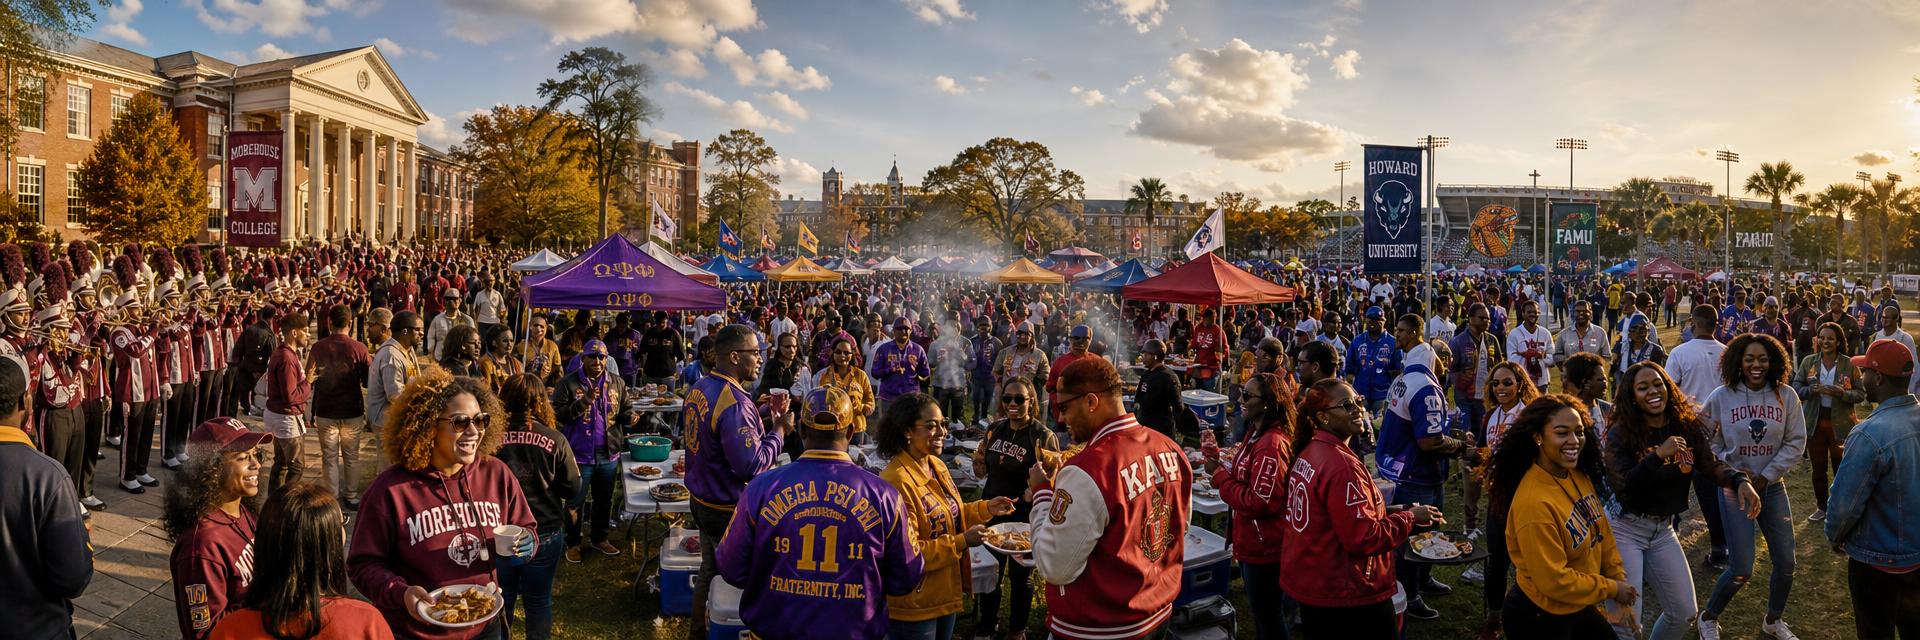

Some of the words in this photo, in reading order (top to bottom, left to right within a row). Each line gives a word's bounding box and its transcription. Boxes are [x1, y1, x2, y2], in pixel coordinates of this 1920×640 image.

[231, 143, 279, 160] MOREHOUSE
[1368, 160, 1418, 176] HOWARD
[232, 166, 278, 212] M
[231, 221, 277, 235] COLLEGE
[1555, 228, 1593, 245] FAMU
[1368, 243, 1418, 258] UNIVERSITY
[606, 292, 652, 307] ΩΨΦ
[502, 431, 555, 452] REHOUSE
[760, 480, 819, 527] OMEGA
[823, 480, 857, 508] PSI
[406, 501, 503, 547] MOREHOUSE
[774, 536, 791, 554] 19
[796, 523, 839, 573] 11
[847, 543, 864, 560] 11
[844, 583, 866, 600] INC.
